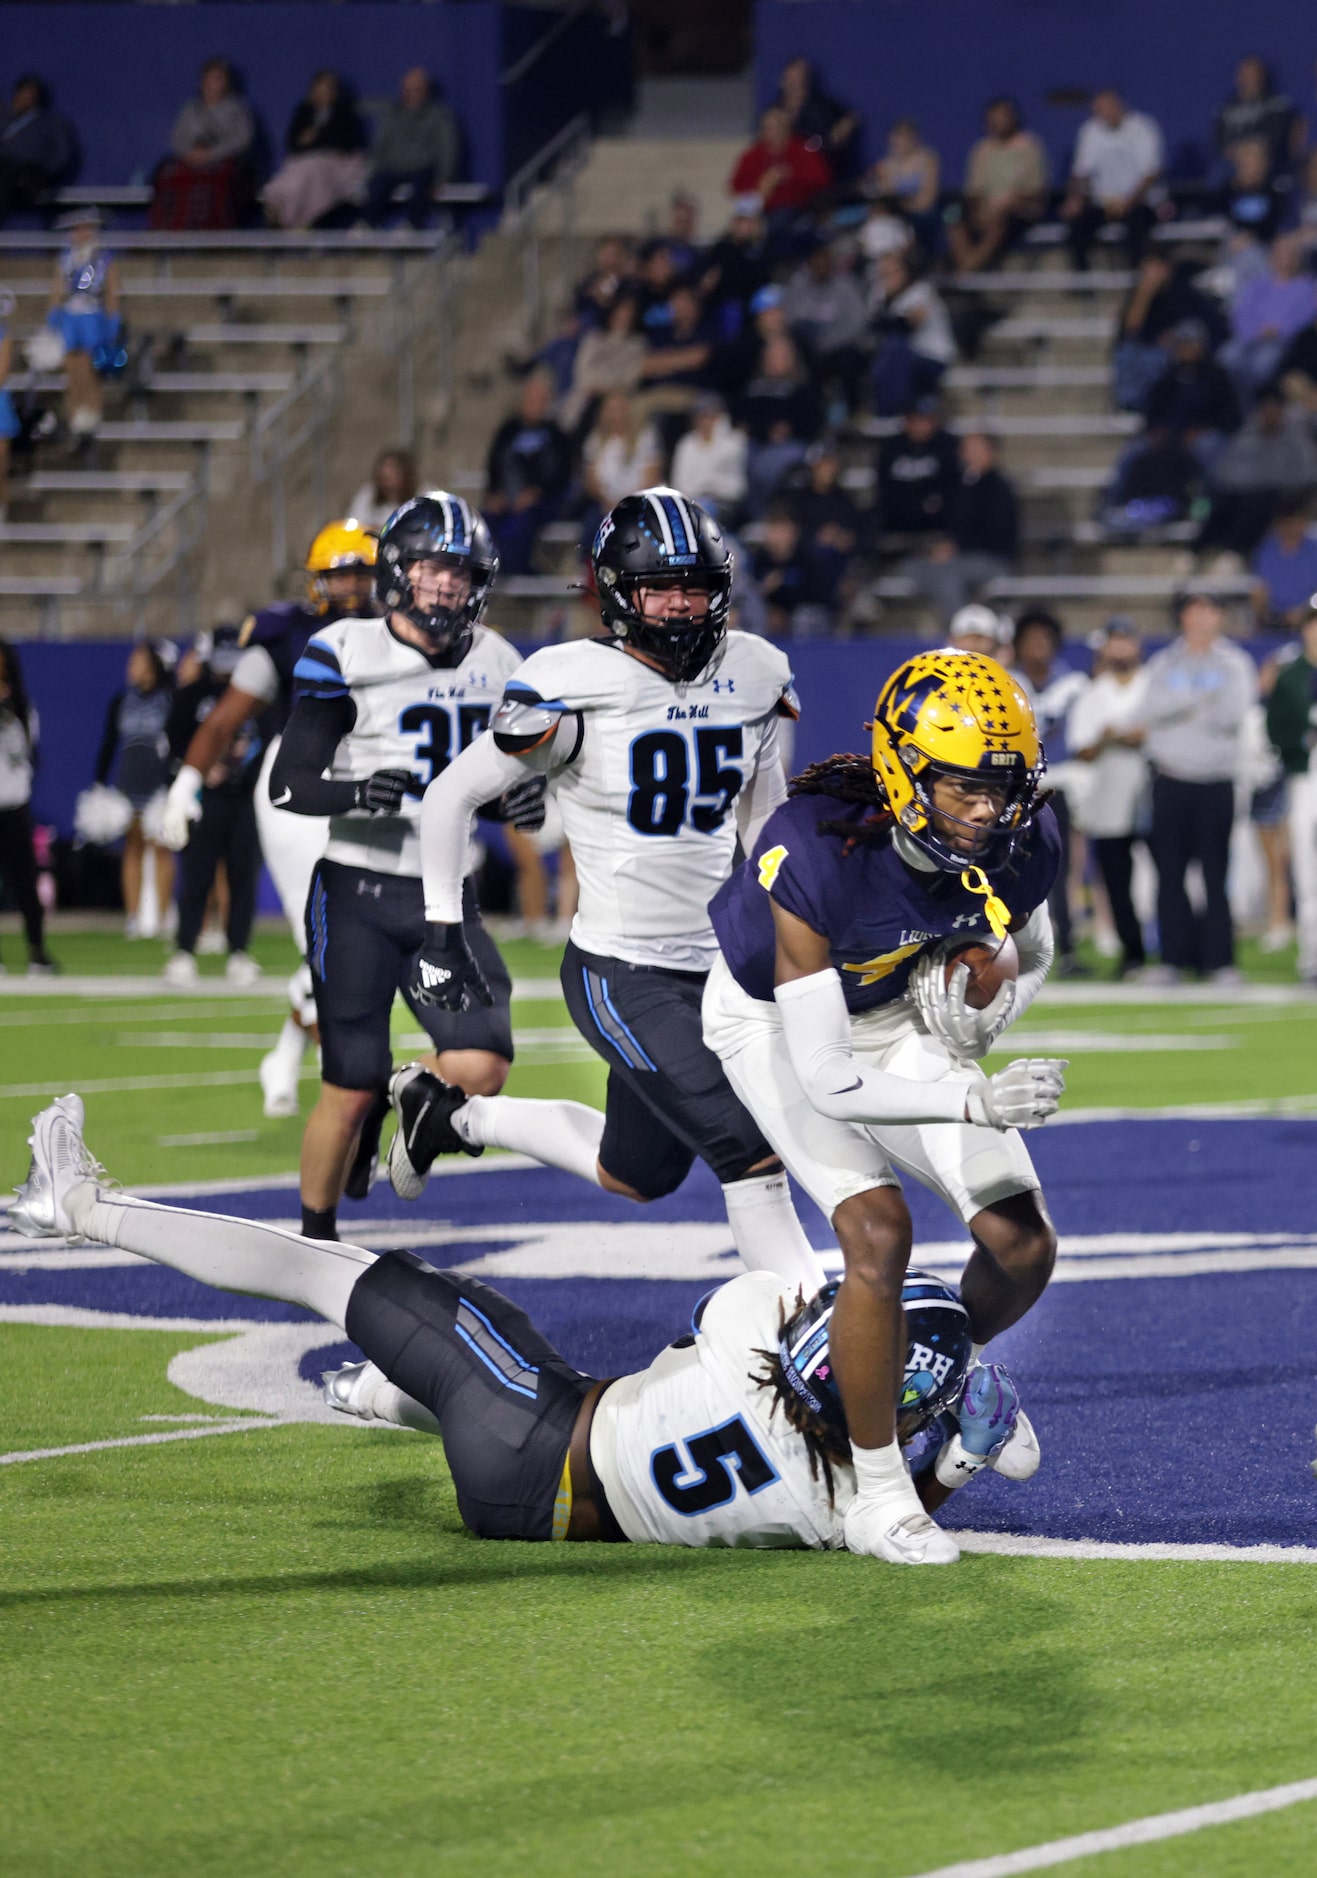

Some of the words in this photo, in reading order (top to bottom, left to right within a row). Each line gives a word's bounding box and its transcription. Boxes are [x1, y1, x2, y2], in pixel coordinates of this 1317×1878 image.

[667, 705, 687, 721] The
[875, 666, 947, 735] M
[626, 722, 744, 838] 85
[991, 753, 1017, 766] GRIT
[757, 844, 789, 892] 4
[899, 929, 943, 947] LION
[905, 1342, 955, 1386] RH
[649, 1411, 782, 1518] 5
